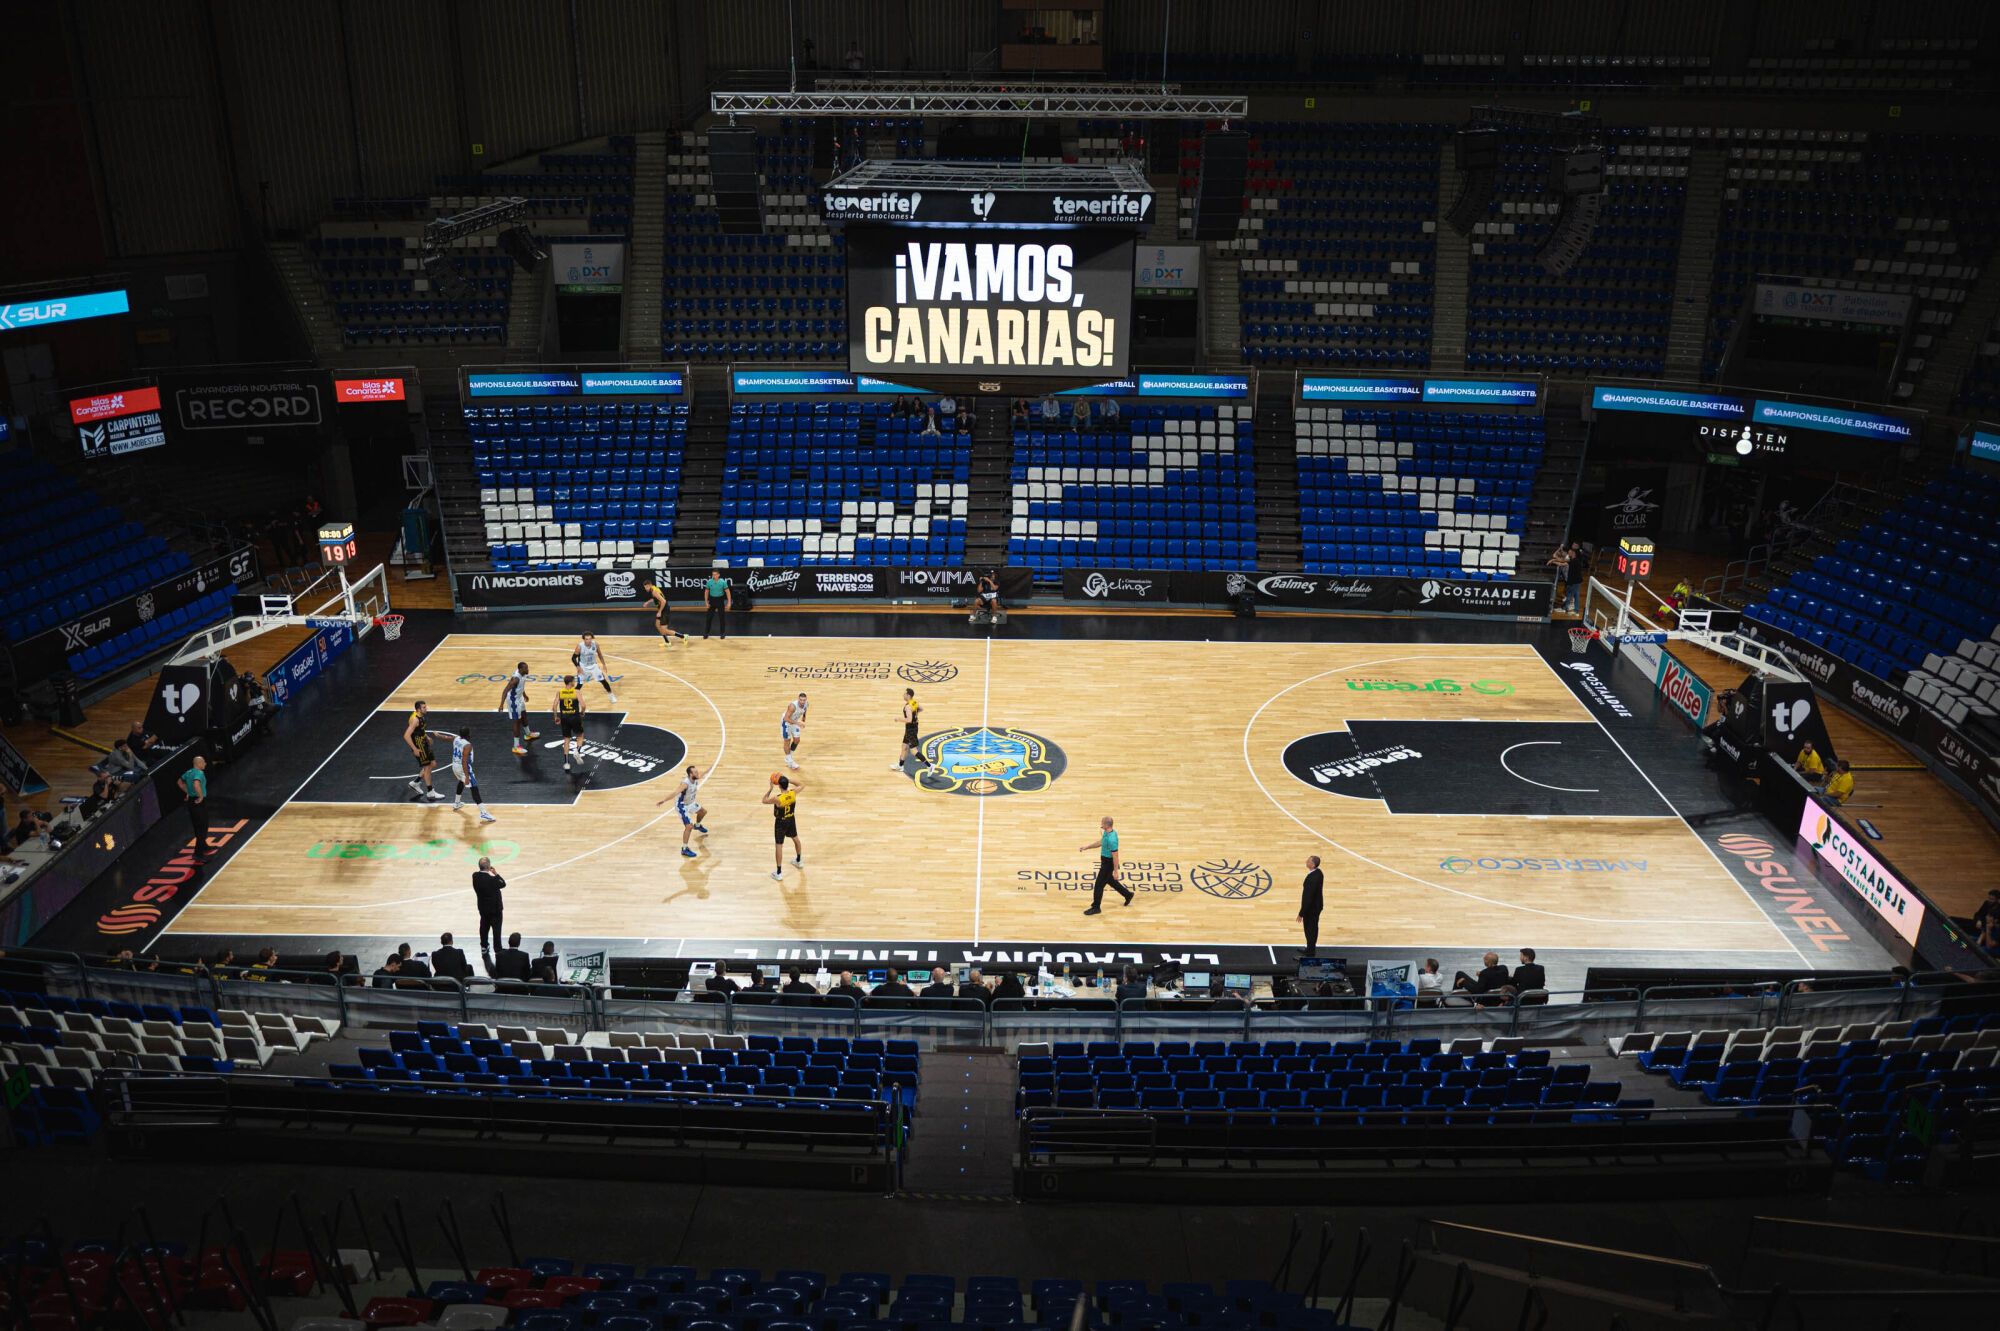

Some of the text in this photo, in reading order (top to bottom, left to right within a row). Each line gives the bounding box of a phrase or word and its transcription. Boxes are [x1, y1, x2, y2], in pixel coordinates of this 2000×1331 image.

[824, 192, 921, 220] tenerife!
[1053, 194, 1152, 222] tenerife!
[826, 211, 864, 219] despierta
[1055, 213, 1093, 221] despierta
[896, 242, 1085, 308] ¡VAMOS,
[864, 306, 1116, 368] CANARIAS!
[251, 383, 304, 393] INDUSTRIAL
[346, 387, 382, 396] Canarias
[362, 380, 381, 389] Islas
[189, 396, 311, 420] RECORD
[1614, 513, 1647, 525] CICAR
[319, 529, 342, 539] 08:00
[323, 540, 357, 562] 19 19
[1630, 544, 1654, 553] 08:00
[1629, 559, 1650, 577] 19
[492, 574, 584, 588] McDonald's
[608, 574, 630, 583] isola
[815, 573, 874, 583] TERRENOS
[900, 571, 976, 585] HOVIMA
[816, 583, 874, 592] YNAVES.COM
[1271, 578, 1319, 594] Balmes
[1442, 586, 1537, 600] COSTAADEJE
[1461, 598, 1494, 606] TENERIFE
[1347, 679, 1463, 694] green
[1660, 660, 1702, 718] Kalise
[1940, 735, 1980, 771] ARMAS
[1477, 858, 1650, 872] AMERESCO
[1832, 834, 1907, 916] COSTAADEJE
[1843, 864, 1883, 909] TENERIFE SUR
[1744, 860, 1851, 953] SUNEL
[854, 1167, 864, 1182] P
